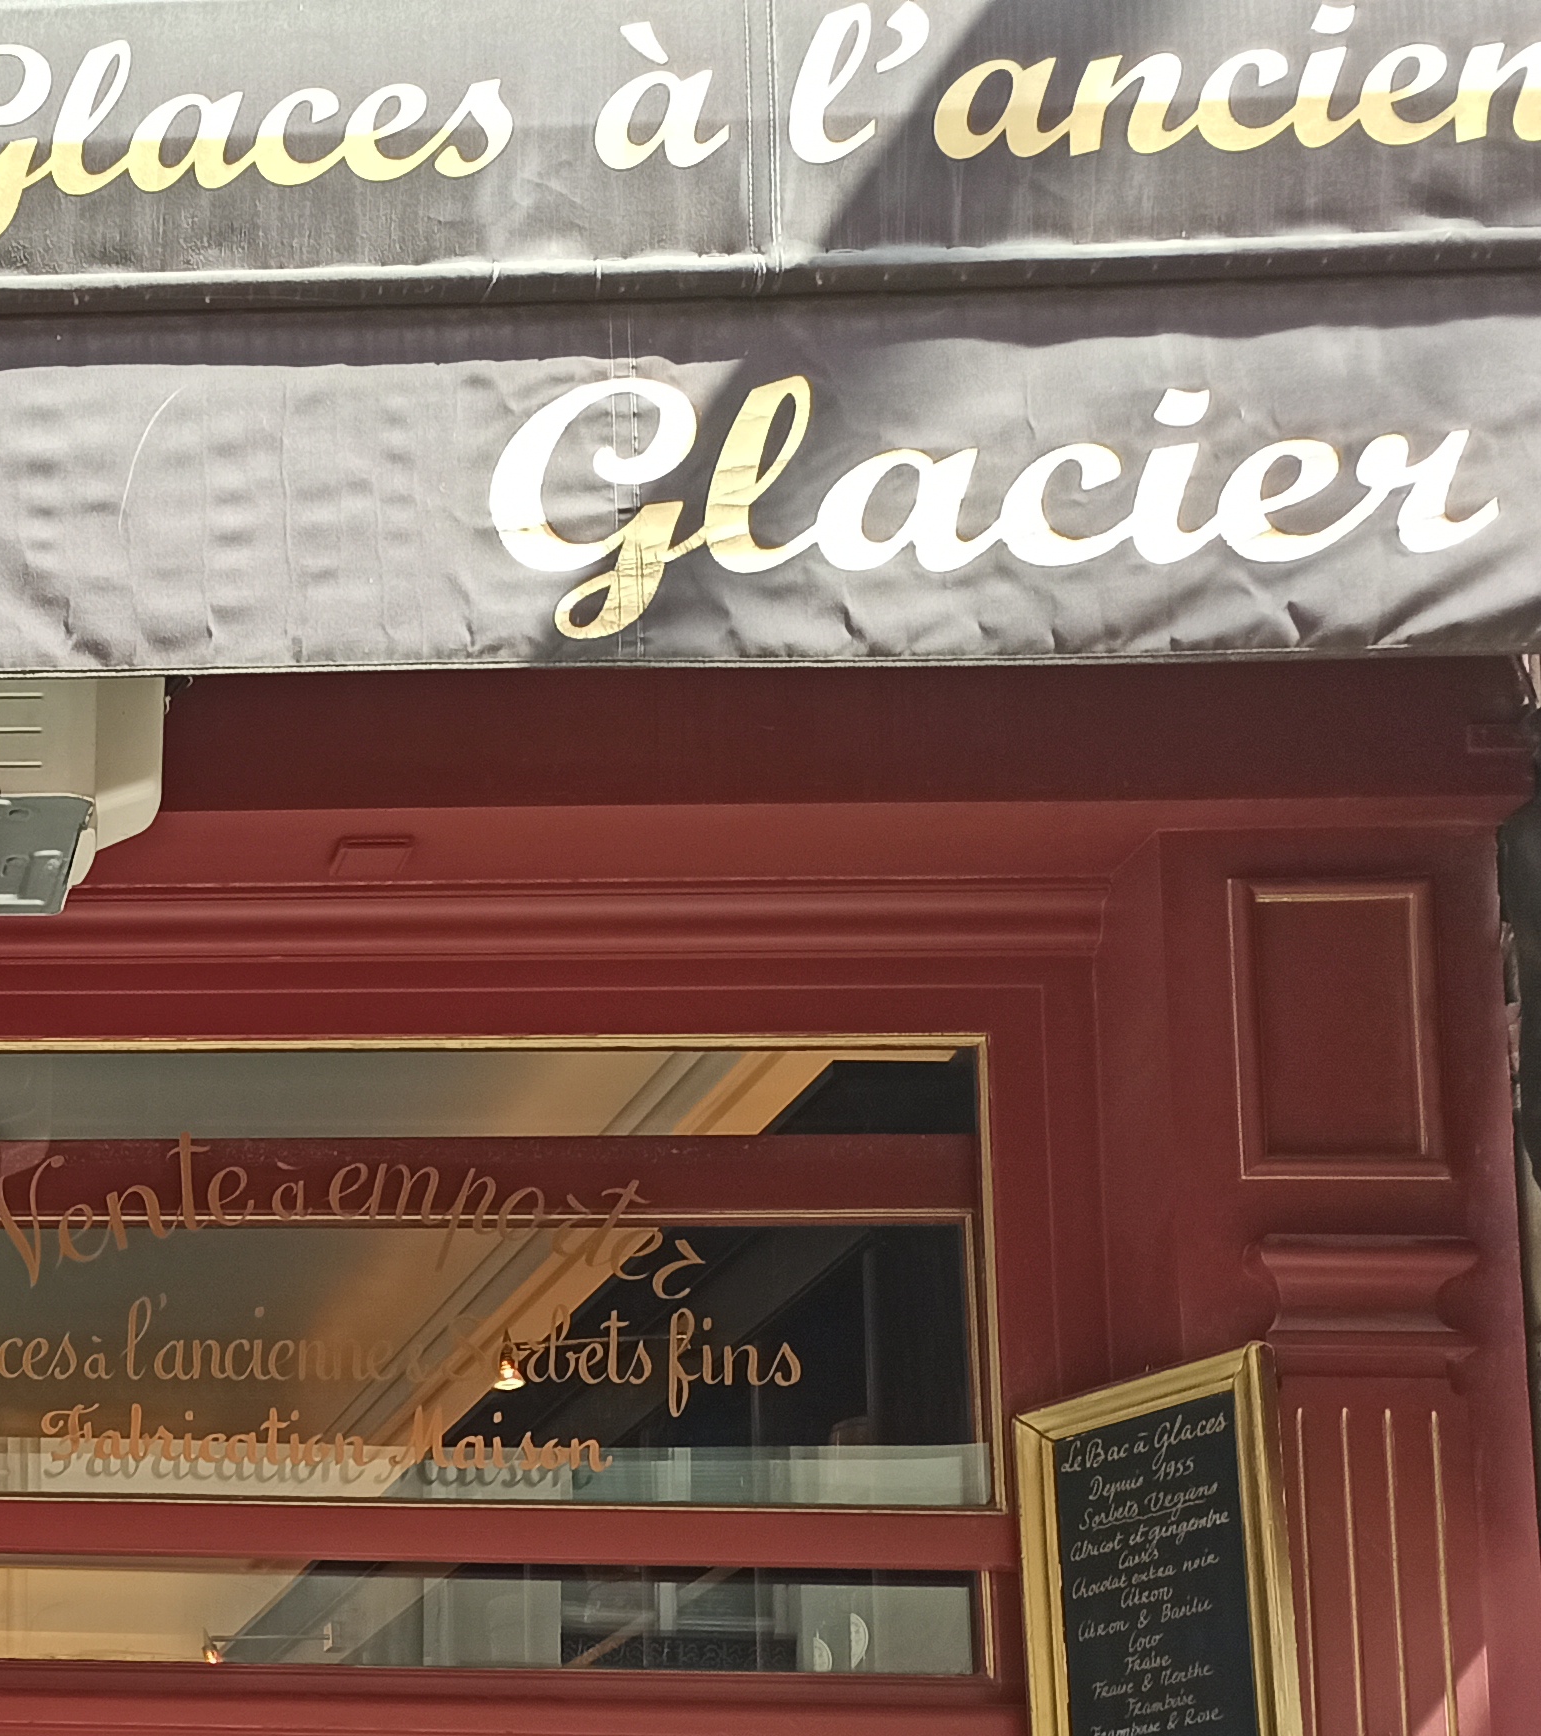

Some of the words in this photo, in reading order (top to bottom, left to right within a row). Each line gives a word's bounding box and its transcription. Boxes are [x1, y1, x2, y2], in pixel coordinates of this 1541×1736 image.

[592, 21, 729, 170] à
[488, 375, 1501, 640] Glacier
[271, 1159, 313, 1220] à
[328, 1162, 706, 1299] emporter
[84, 1335, 115, 1380] à
[121, 1292, 397, 1381] l'ancienne
[668, 1307, 801, 1417] fins
[41, 1402, 369, 1467] Fabrication
[389, 1405, 613, 1472] Maison
[1061, 1440, 1081, 1472] Le
[1086, 1438, 1129, 1468] Bac
[1133, 1432, 1150, 1454] à
[1152, 1411, 1228, 1470] Glaces
[1088, 1470, 1144, 1503] Depuis
[1153, 1456, 1195, 1482] 1955
[1079, 1500, 1139, 1530] Sorbets
[1144, 1482, 1218, 1521] Vegans
[1128, 1524, 1148, 1545] et
[1072, 1573, 1128, 1599] Chocolat
[1131, 1564, 1177, 1585] extra
[1182, 1549, 1220, 1571] noir
[1120, 1586, 1173, 1608] Citron
[1078, 1620, 1130, 1642] Citron
[1137, 1608, 1152, 1629] &
[1128, 1630, 1164, 1653] Coco
[1124, 1650, 1172, 1675] Fraise
[1092, 1680, 1134, 1701] Fraise
[1141, 1672, 1153, 1692] &
[1184, 1707, 1224, 1725] Rose
